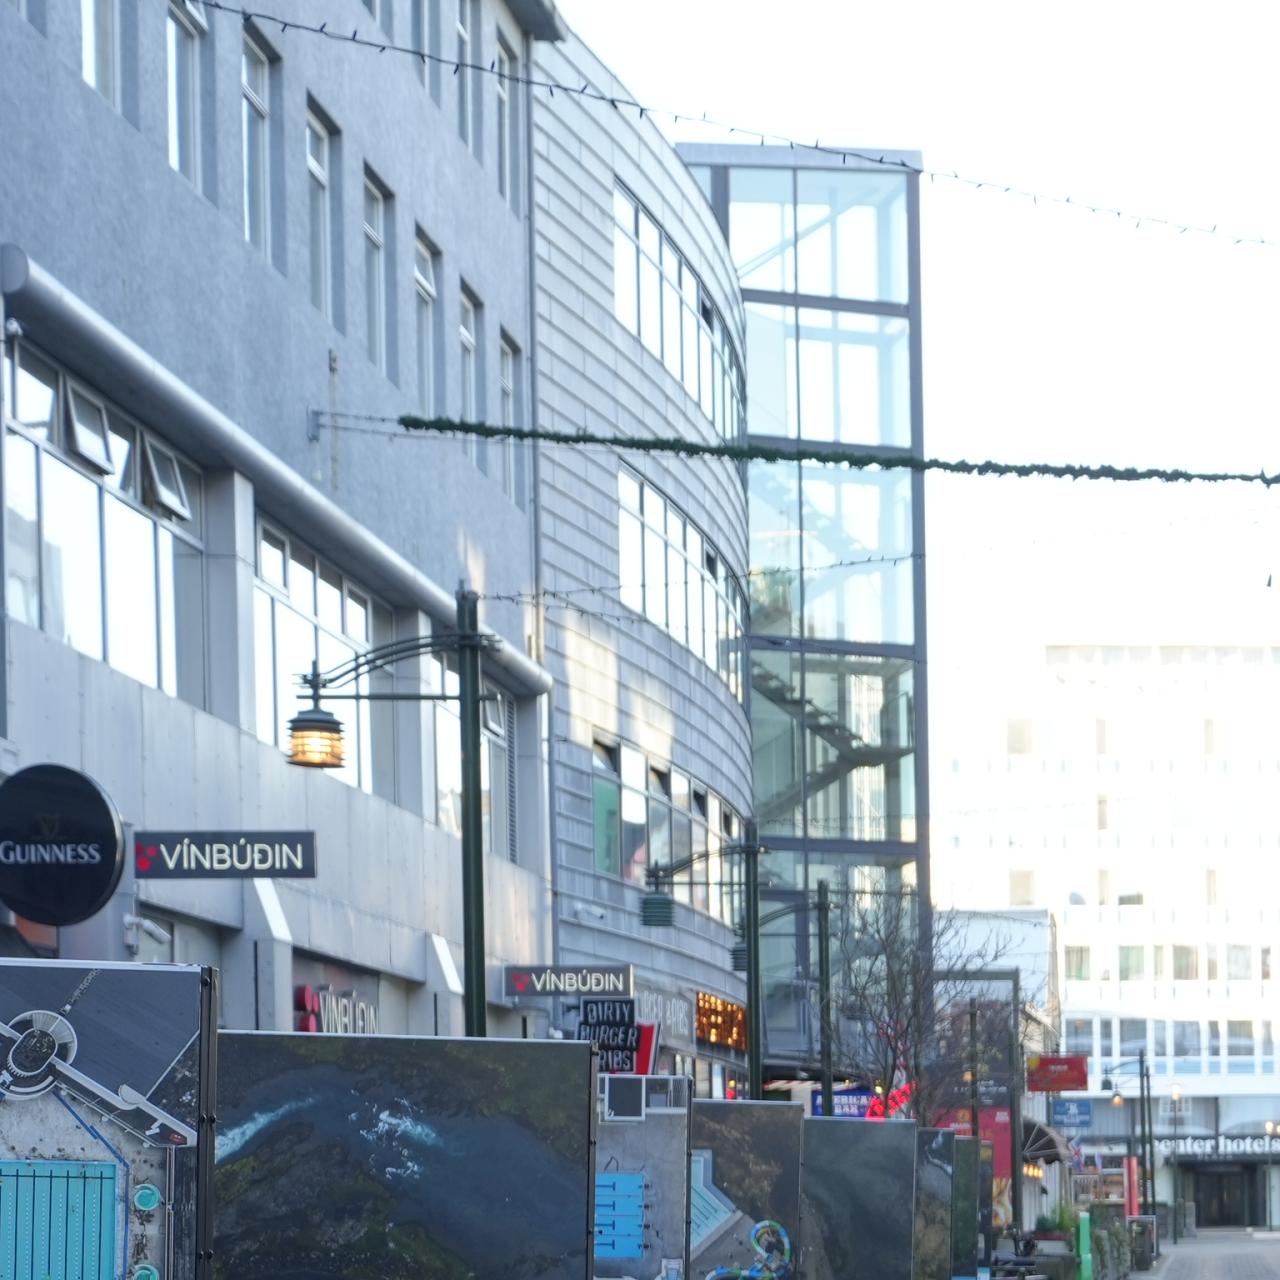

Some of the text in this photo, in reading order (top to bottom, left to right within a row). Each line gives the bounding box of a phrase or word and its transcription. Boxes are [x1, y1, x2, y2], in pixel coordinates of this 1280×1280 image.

[0, 840, 101, 865] GUINNESS
[160, 838, 303, 870] VÍNBÚÐIN
[531, 969, 624, 992] VÍNBÚÐIN
[587, 1001, 631, 1025] DIRTY
[815, 1093, 872, 1107] AERICA
